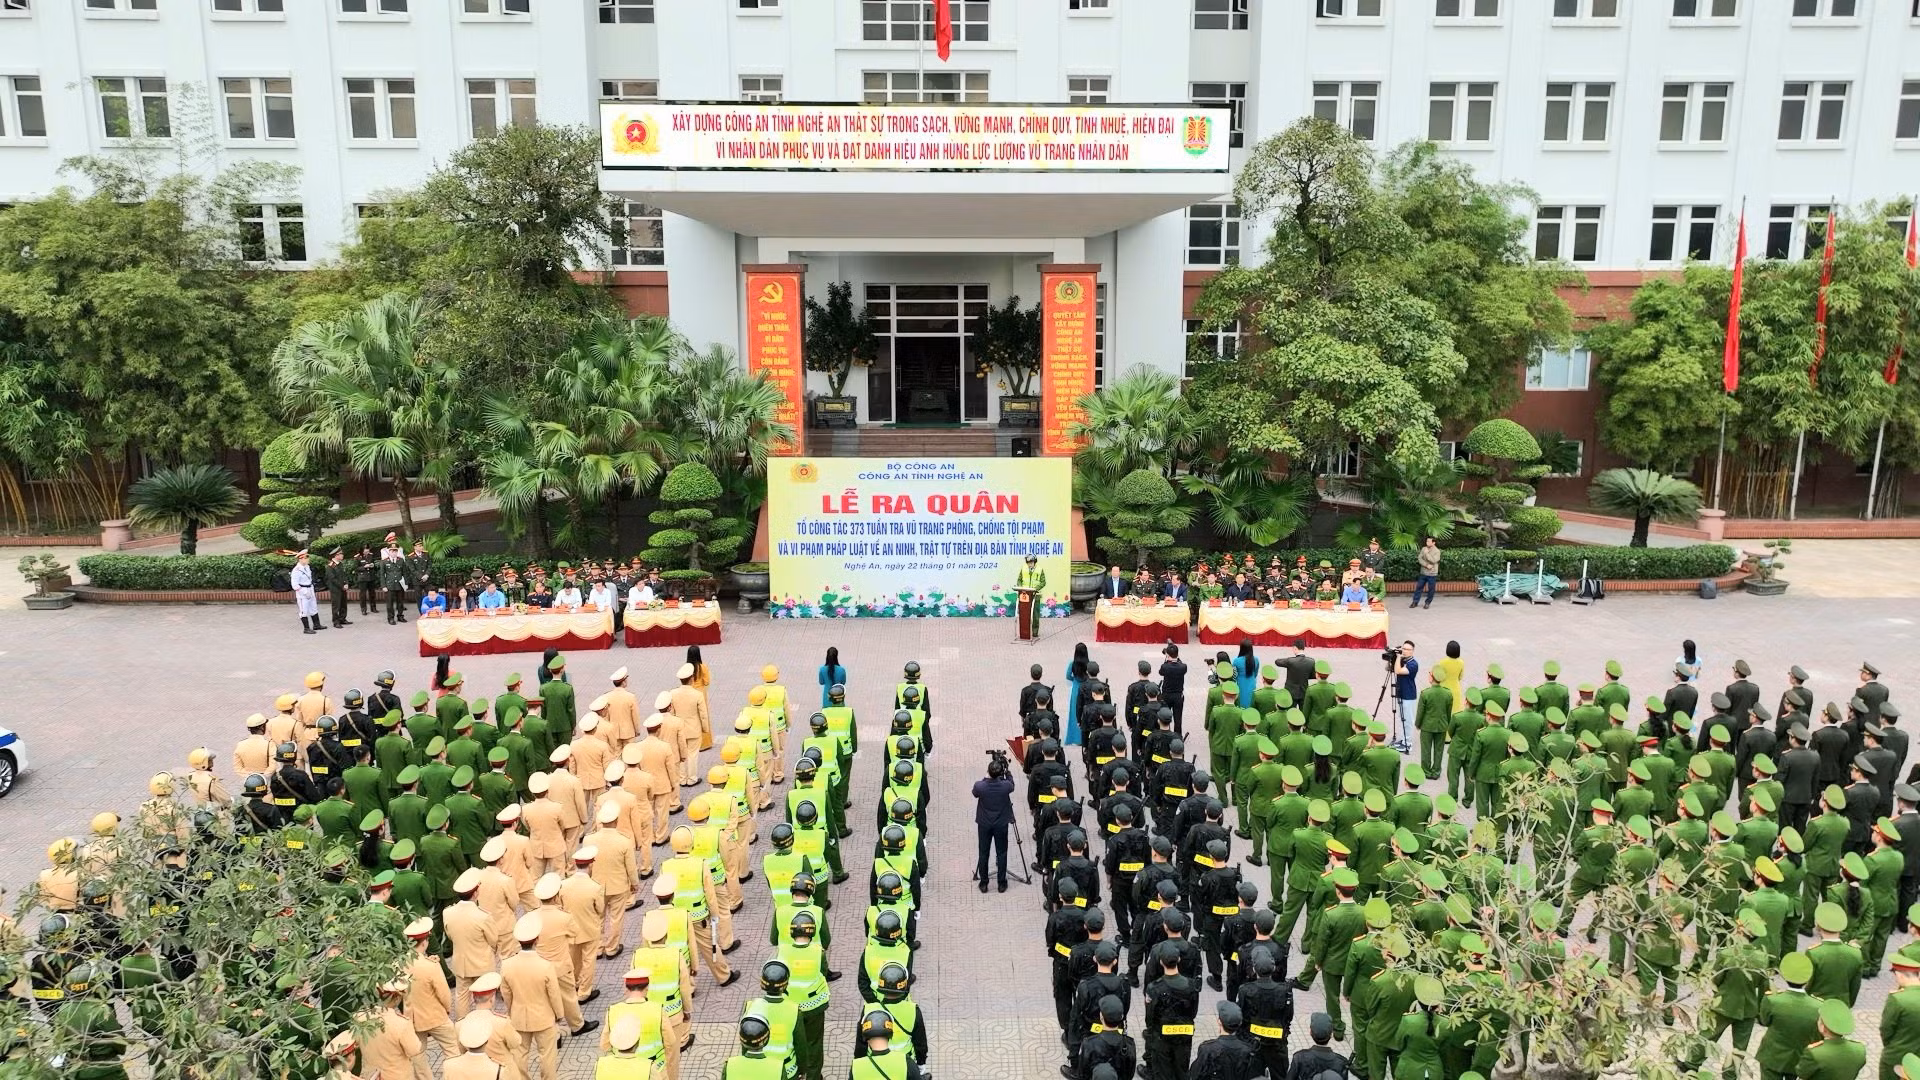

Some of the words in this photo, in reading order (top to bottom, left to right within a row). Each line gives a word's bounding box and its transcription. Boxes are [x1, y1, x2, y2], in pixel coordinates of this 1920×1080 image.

[672, 110, 691, 131] XÂY
[694, 112, 722, 135] DỰNG
[725, 110, 751, 132] CÔNG
[756, 115, 769, 132] AN
[772, 109, 794, 132] TỈNH
[798, 112, 824, 136] NGHỆ
[828, 115, 841, 132] AN
[844, 112, 867, 137] THẬT
[871, 114, 885, 137] SỰ
[887, 116, 918, 133] TRONG
[922, 116, 951, 137] SẠCH,
[954, 112, 980, 134] VỮNG
[984, 116, 1016, 137] MẠNH,
[1019, 113, 1049, 134] CHÍNH
[1052, 116, 1072, 135] QUY,
[1100, 113, 1129, 138] NHUỆ,
[1132, 113, 1155, 138] HIỆN
[1158, 117, 1174, 138] ĐẠI
[716, 138, 725, 159] VÌ
[728, 138, 756, 159] NHÂN
[760, 138, 780, 159] DÂN
[783, 142, 809, 163] PHỤC
[812, 142, 824, 164] VỤ
[828, 138, 840, 159] VÀ
[843, 143, 861, 164] ĐẠT
[864, 143, 891, 160] DANH
[894, 139, 916, 164] HIỆU
[920, 143, 940, 160] ANH
[944, 139, 969, 160] HÙNG
[973, 142, 991, 164] LỰC
[994, 142, 1026, 164] LƯỢNG
[1029, 140, 1041, 160] VŨ
[1044, 144, 1075, 160] TRANG
[1078, 140, 1105, 160] NHÂN
[1109, 140, 1129, 160] DÂN
[858, 472, 890, 480] CÔNG
[912, 471, 934, 480] TỈNH
[938, 472, 965, 481] NGHỆ
[887, 464, 901, 472] BỘ
[905, 462, 937, 470] CÔNG
[822, 488, 859, 514] LỄ
[872, 495, 915, 514] RA
[927, 490, 1019, 516] QUÂN
[797, 517, 807, 535] TỔ
[809, 520, 831, 535] CÔNG
[834, 520, 848, 535] TÁC
[850, 522, 865, 535] 373
[867, 518, 887, 535] TUẦN
[890, 522, 905, 535] TRA
[906, 520, 917, 535] VŨ
[919, 522, 944, 535] TRANG
[946, 519, 976, 536] PHÒNG,
[978, 517, 1005, 535] CHỐNG
[1007, 520, 1019, 538] TỘI
[1022, 522, 1045, 538] PHẠM
[778, 540, 789, 555] VÀ
[790, 543, 798, 555] VI
[800, 543, 824, 559] PHẠM
[826, 540, 847, 555] PHÁP
[850, 541, 868, 559] LUẬT
[870, 539, 880, 555] VỀ
[882, 543, 894, 555] AN
[896, 543, 918, 557] NINH,
[920, 540, 939, 558] TRẬT
[941, 541, 951, 558] TỰ
[953, 540, 973, 555] TRÊN
[975, 543, 988, 558] ĐỊA
[990, 540, 1007, 555] BÀN
[1009, 538, 1027, 555] TỈNH
[1030, 540, 1050, 558] NGHỆ
[1053, 543, 1064, 555] AN
